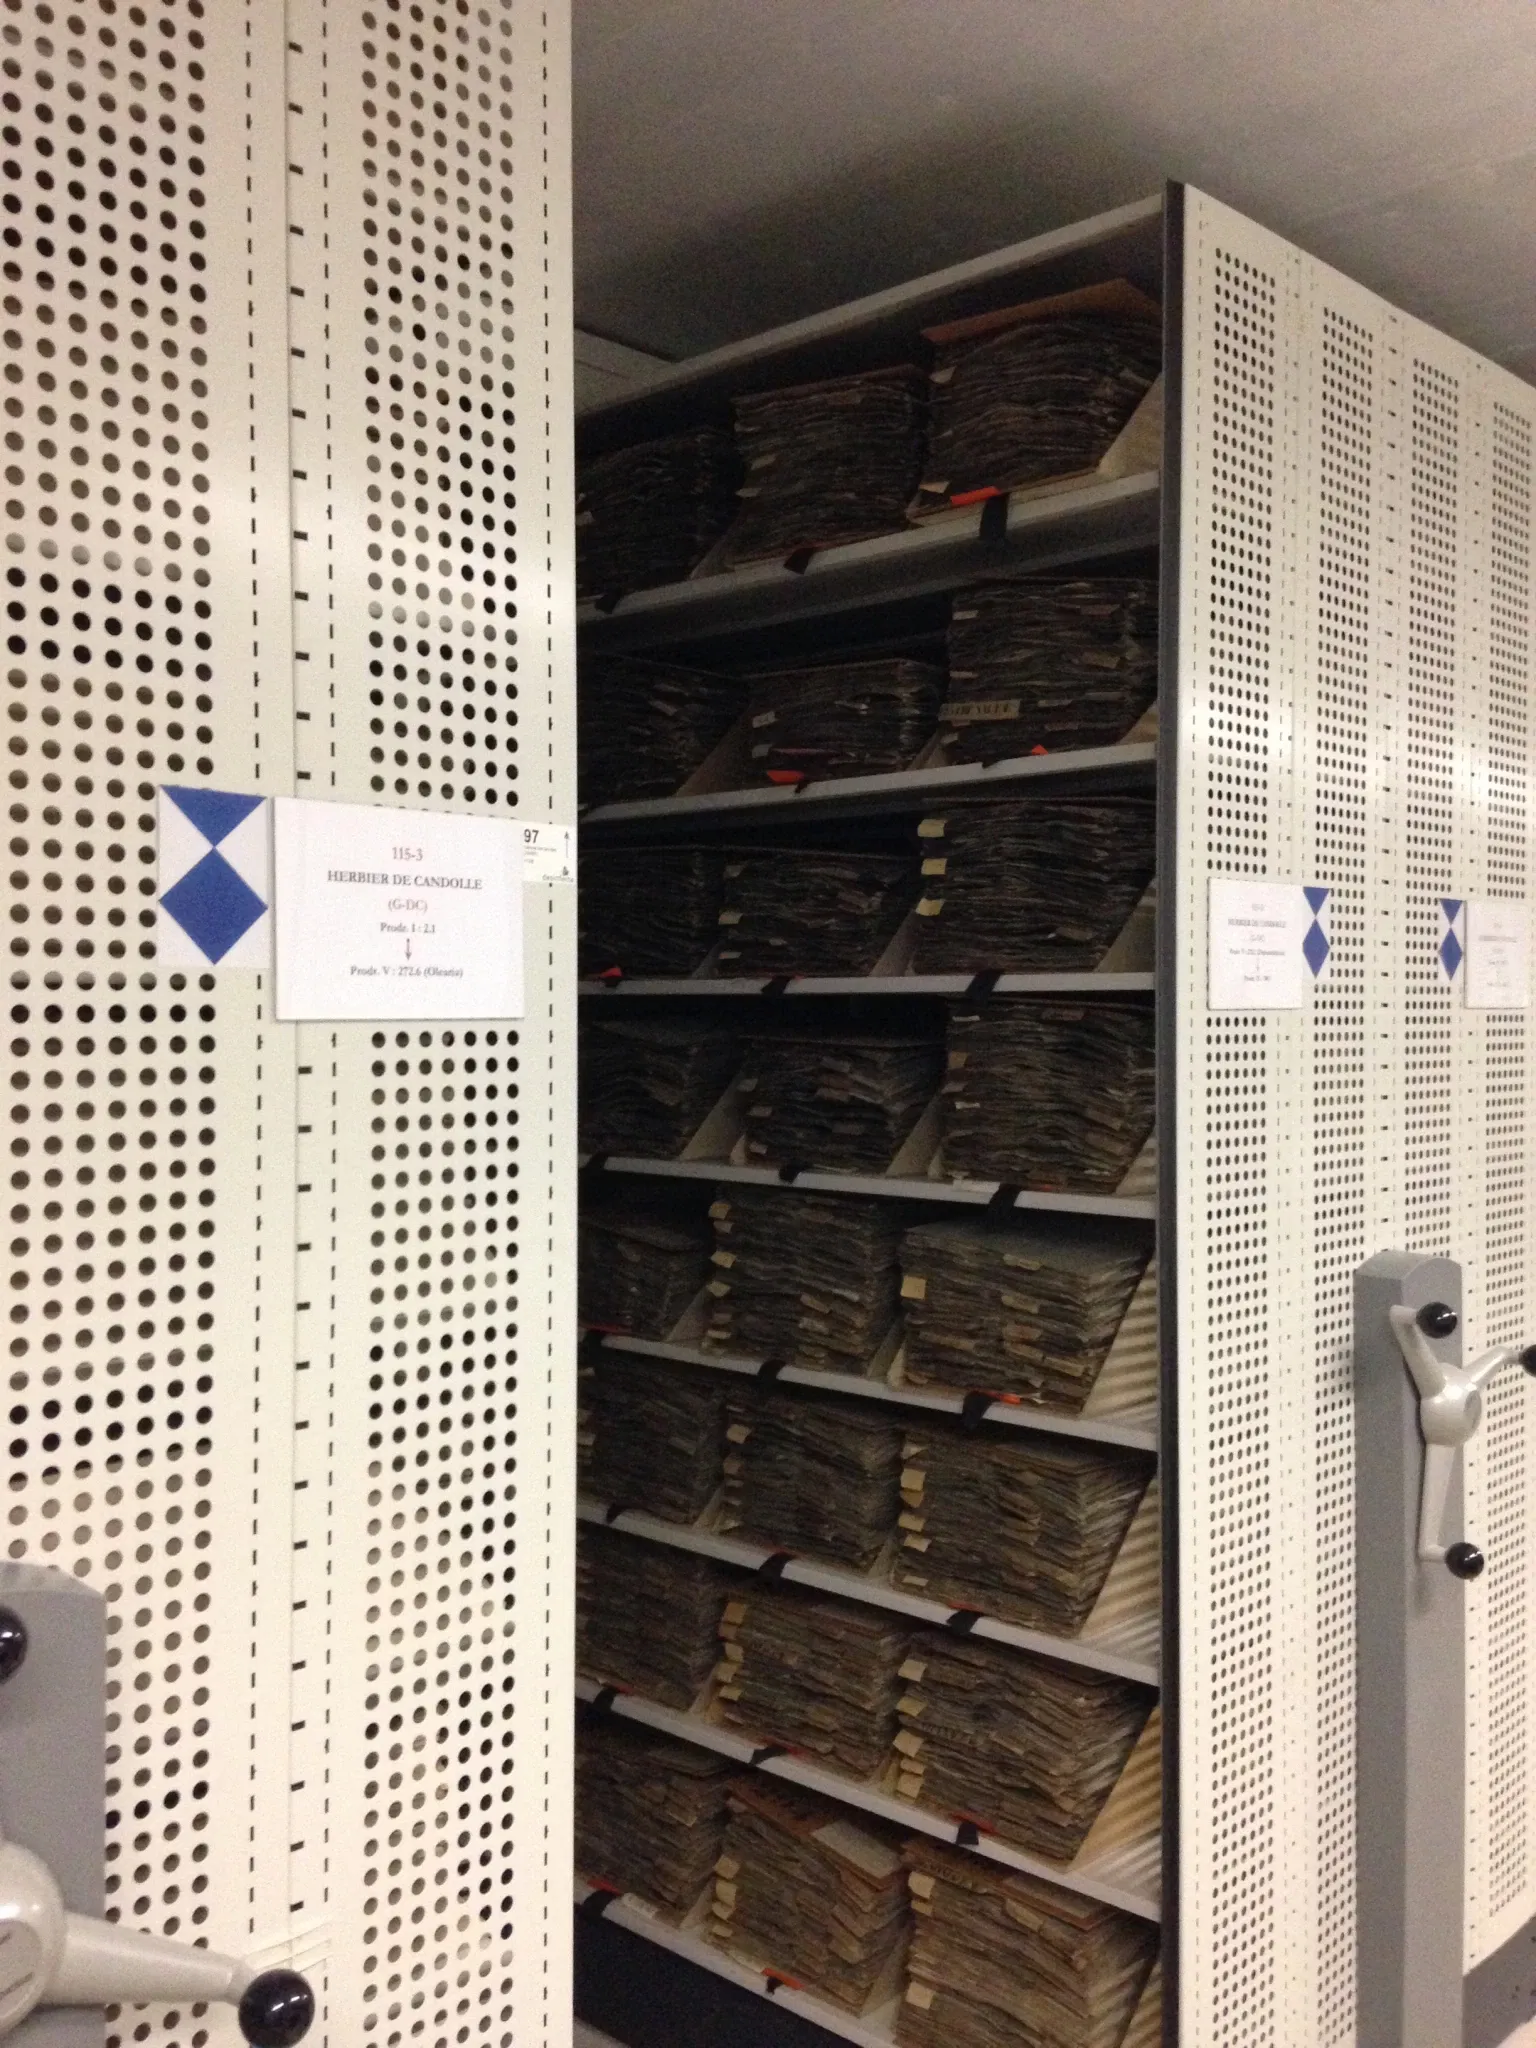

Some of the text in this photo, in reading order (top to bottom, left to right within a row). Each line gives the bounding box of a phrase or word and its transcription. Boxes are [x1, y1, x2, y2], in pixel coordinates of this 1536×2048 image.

[523, 828, 540, 844] 97
[391, 846, 424, 862] 115-3
[327, 869, 483, 890] HERBIER DE CANDOLLE
[387, 898, 429, 913] (G-DC)
[382, 965, 391, 976] V
